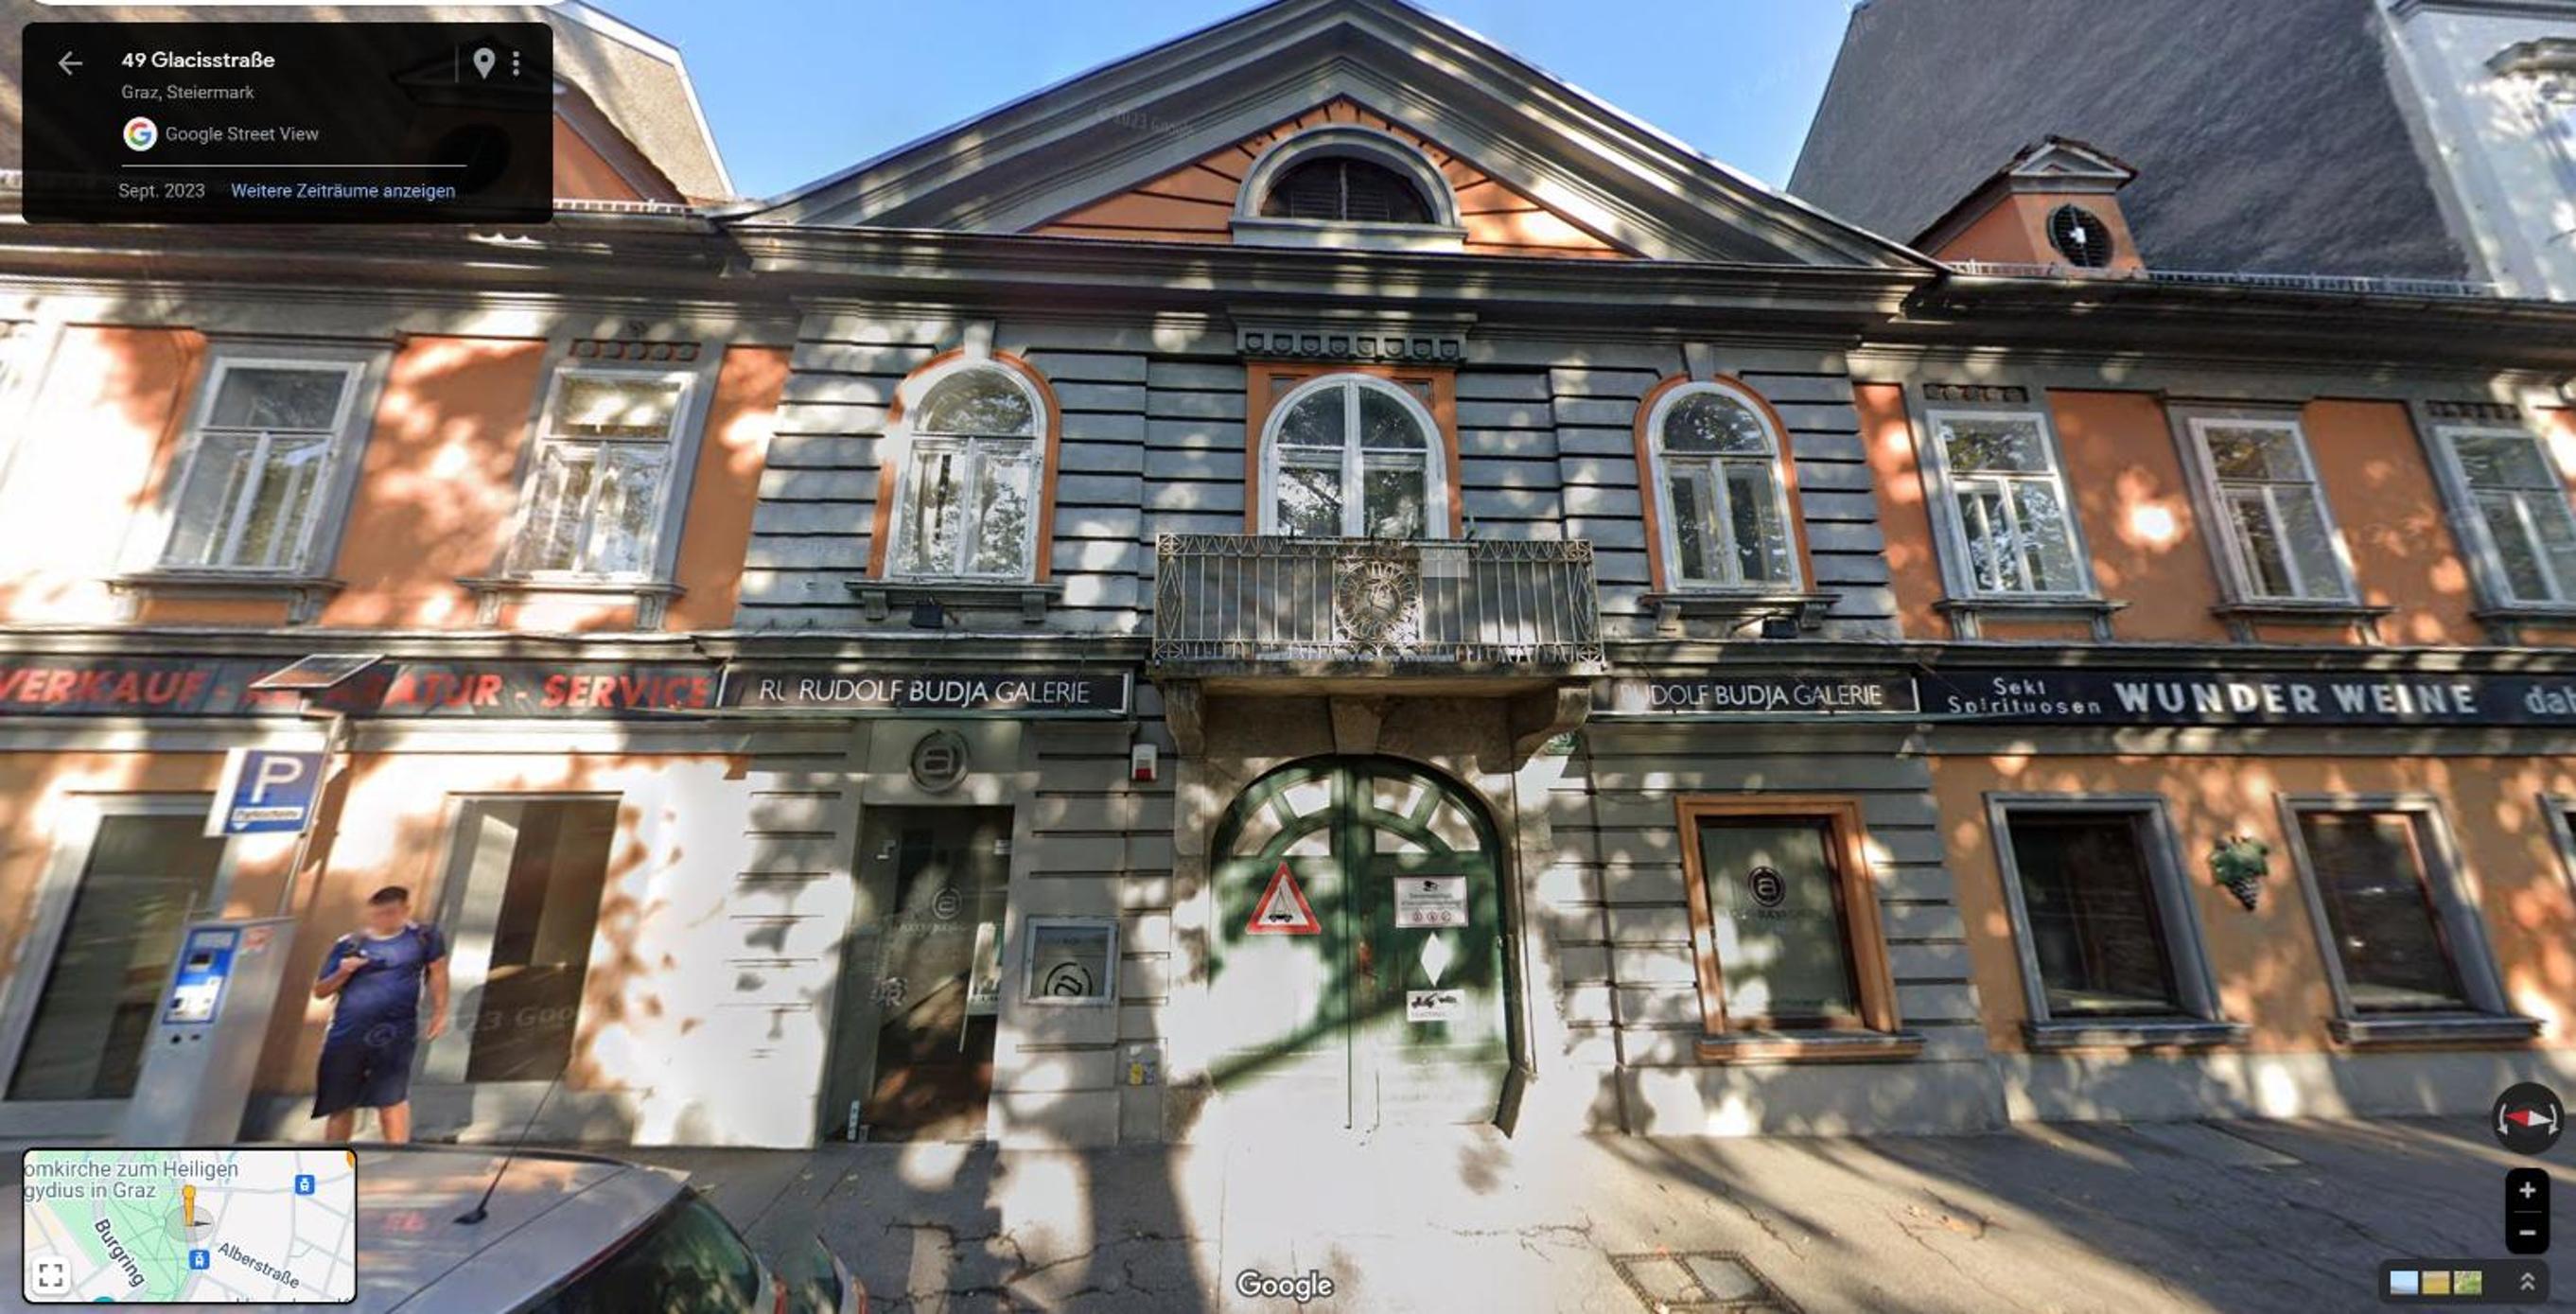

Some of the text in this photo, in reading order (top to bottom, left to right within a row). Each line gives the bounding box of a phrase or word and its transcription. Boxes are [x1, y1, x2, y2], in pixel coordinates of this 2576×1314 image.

[542, 675, 710, 710] SERVICE
[798, 678, 903, 702] RUDOLF
[909, 679, 990, 708] BUDJA
[995, 680, 1091, 705] GALERIE
[1715, 686, 1788, 711] BUDJA
[1794, 684, 1883, 706] GALERIE
[1947, 695, 2102, 715] Spirituosen
[2112, 681, 2478, 715] WUNDER WEINE
[251, 756, 304, 803] P
